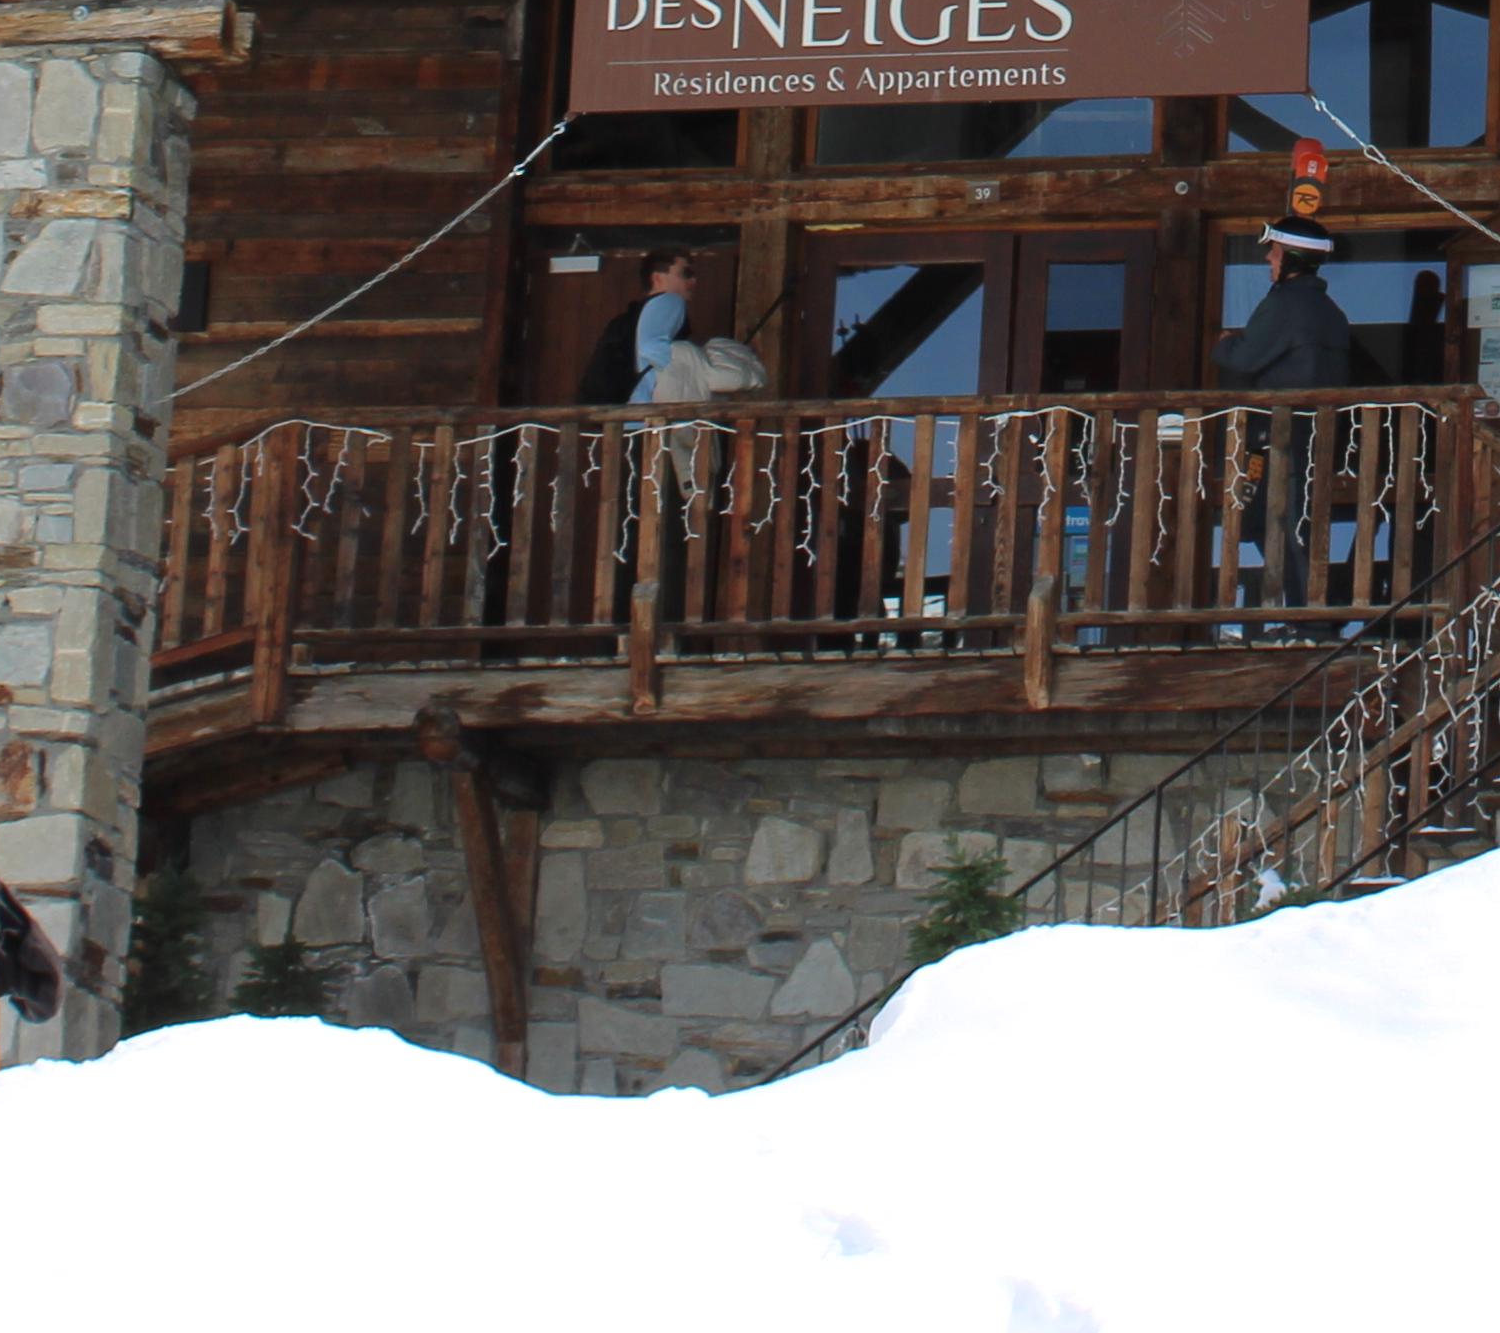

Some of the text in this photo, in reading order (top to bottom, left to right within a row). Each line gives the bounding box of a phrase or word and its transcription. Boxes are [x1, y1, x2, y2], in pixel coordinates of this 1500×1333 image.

[653, 63, 1067, 97] Résidences & Appartements
[975, 188, 991, 200] 39
